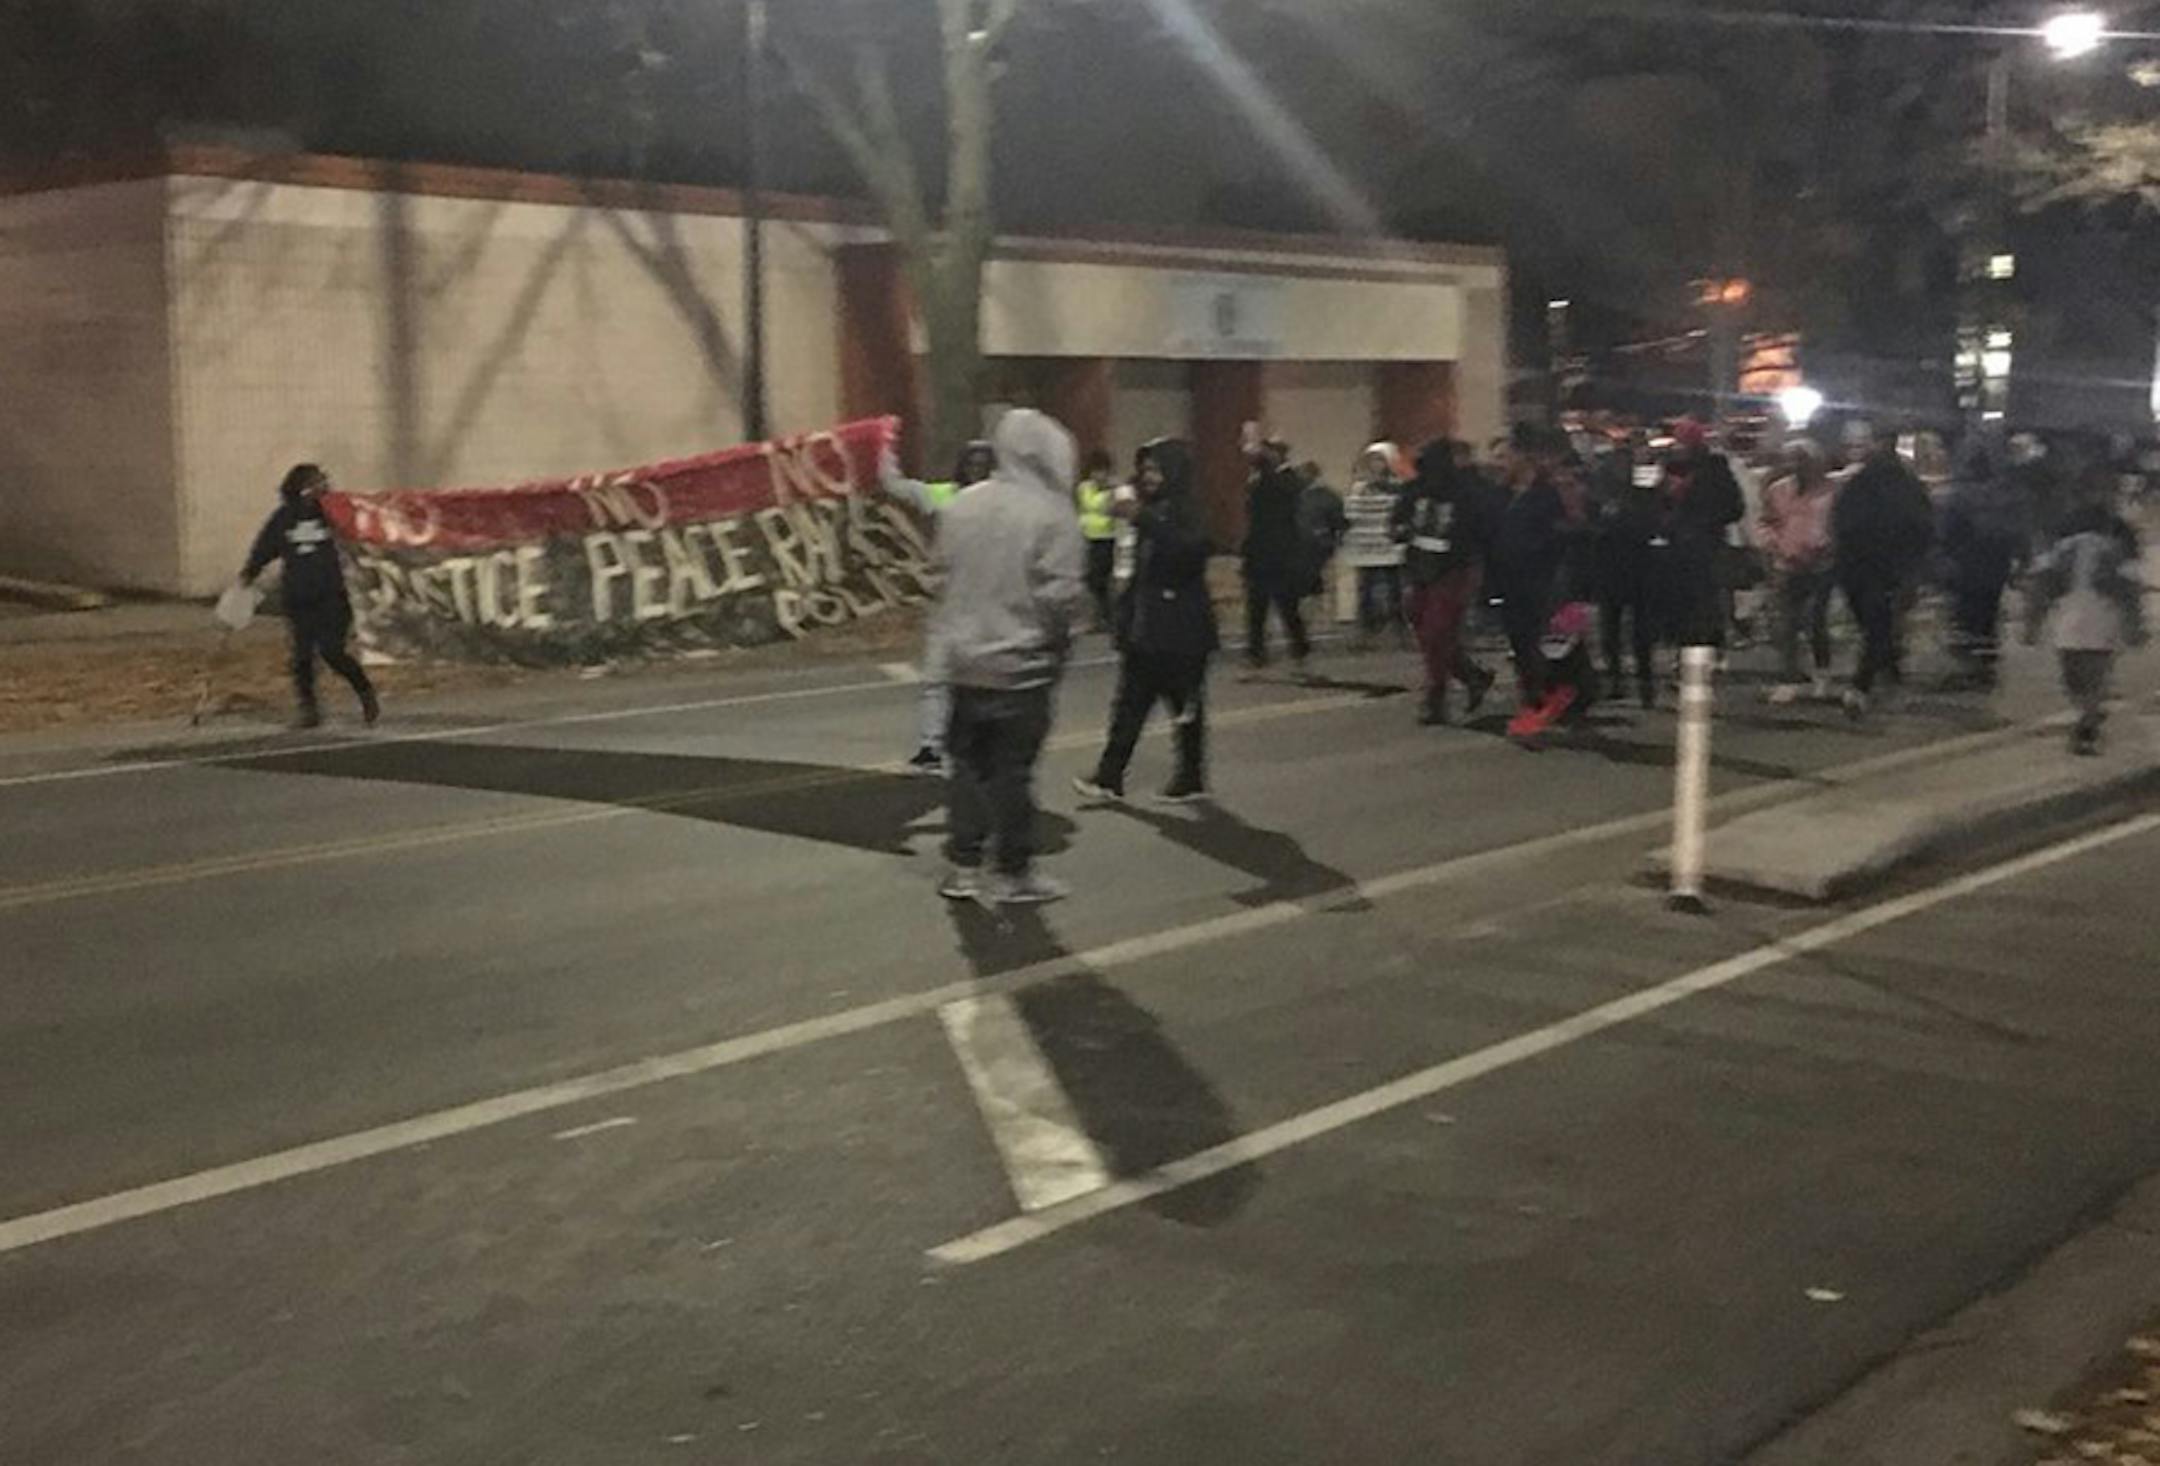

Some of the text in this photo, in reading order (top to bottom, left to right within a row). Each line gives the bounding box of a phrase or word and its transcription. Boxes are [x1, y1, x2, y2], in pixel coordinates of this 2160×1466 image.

[568, 472, 670, 529] NO
[761, 431, 854, 504] NO
[583, 516, 766, 623] PEACE
